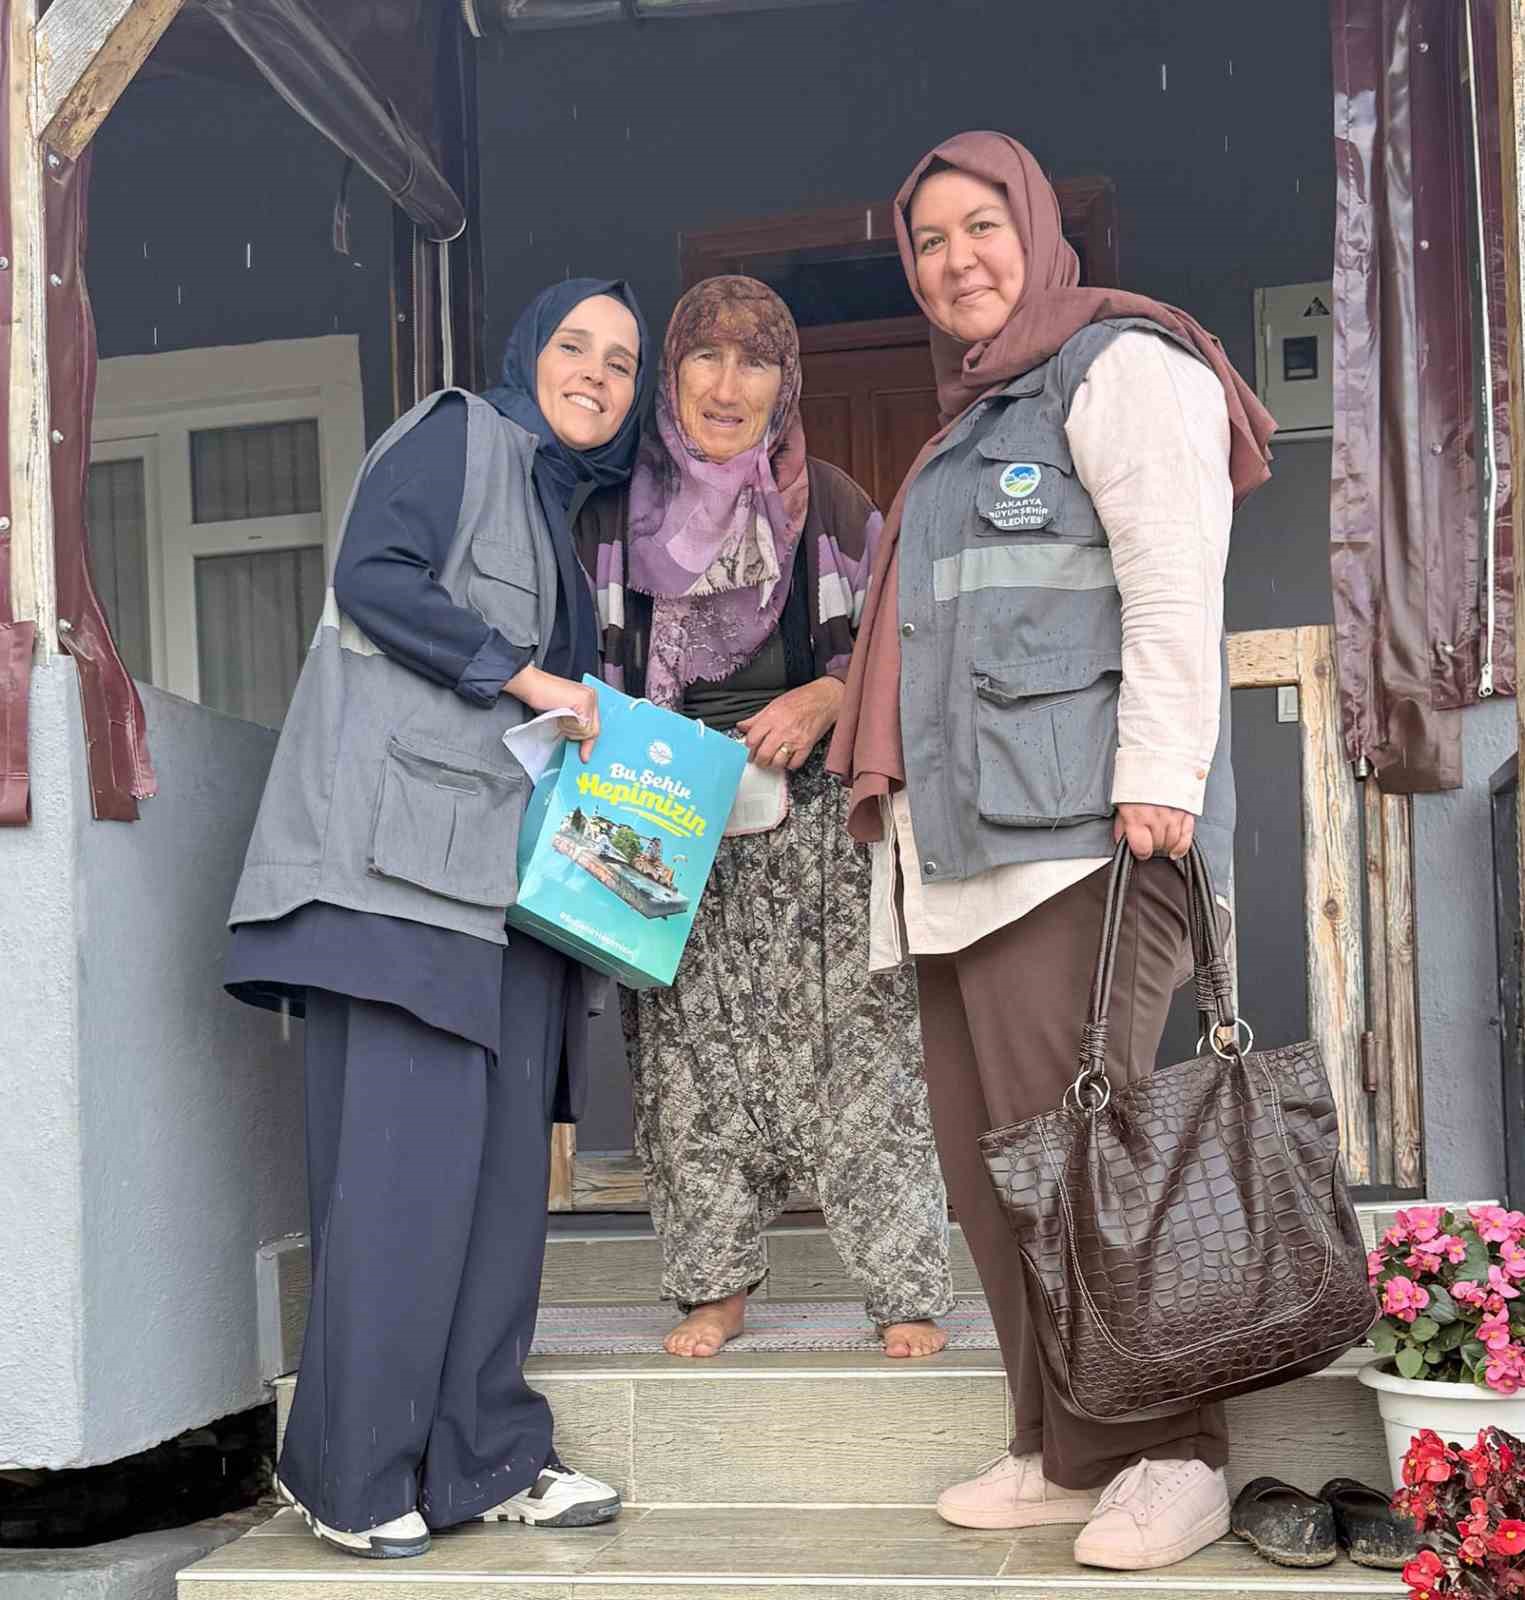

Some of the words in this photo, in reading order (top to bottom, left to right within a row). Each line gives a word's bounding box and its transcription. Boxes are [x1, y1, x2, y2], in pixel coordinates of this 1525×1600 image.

[993, 498, 1042, 510] SAKARYA
[609, 763, 637, 781] Bu
[640, 769, 691, 799] Şehir
[576, 773, 706, 837] Hepimizin
